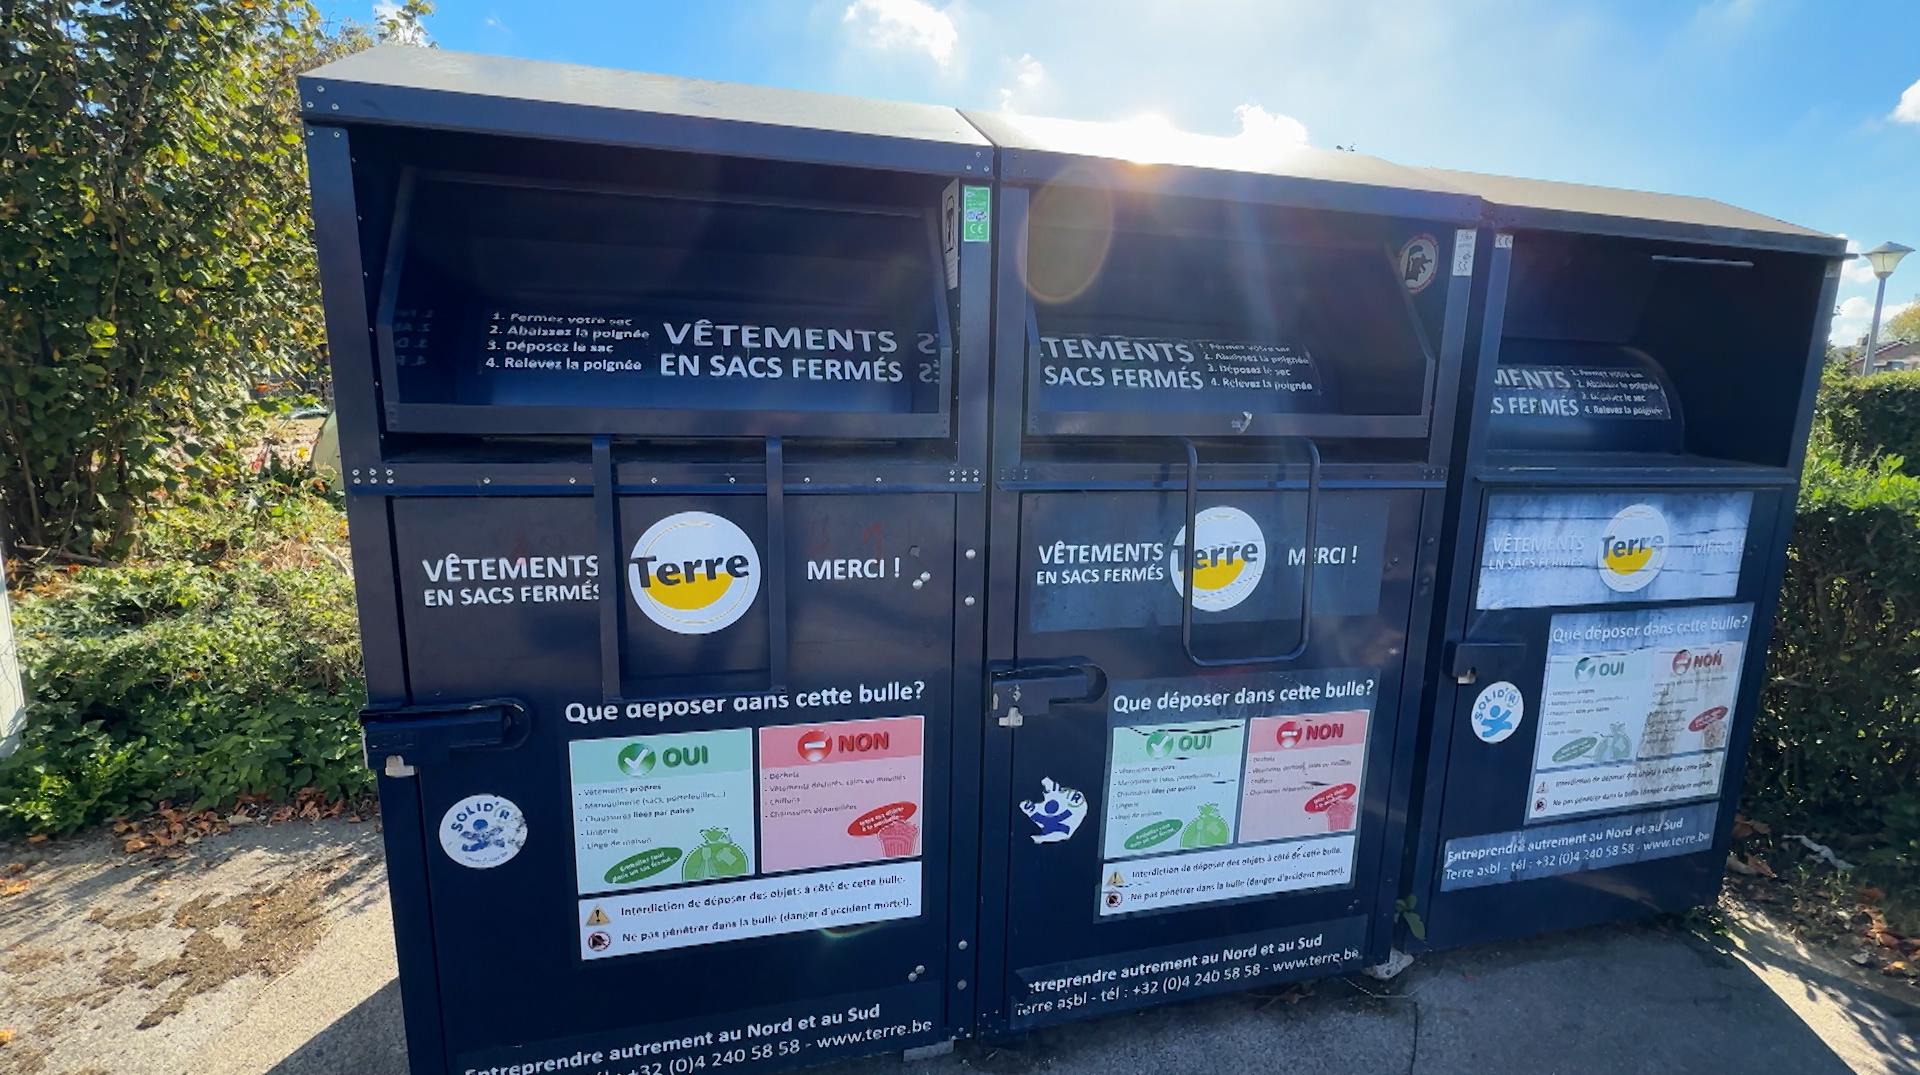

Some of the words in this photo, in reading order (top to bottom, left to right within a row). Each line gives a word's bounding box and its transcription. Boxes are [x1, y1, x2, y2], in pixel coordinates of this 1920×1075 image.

[489, 325, 502, 334] 2.
[507, 325, 572, 336] Abaissez
[576, 327, 588, 337] la
[592, 328, 649, 341] poignée
[663, 319, 897, 352] VÊTEMENTS
[486, 340, 501, 350] 3.
[506, 341, 569, 353] Déposez
[573, 341, 586, 352] le
[1040, 337, 1194, 363] TEMENTS
[485, 357, 500, 368] 4.
[504, 357, 562, 369] Relevez
[566, 358, 579, 369] la
[583, 359, 642, 372] poignée
[660, 353, 700, 376] EN
[709, 354, 783, 378] SACS
[793, 356, 903, 383] FERMÉS
[1044, 365, 1105, 387] SACS
[1112, 367, 1204, 390] FERMÉS
[1509, 396, 1579, 416] FERMÉS
[1038, 540, 1164, 564] VÊTEMENTS
[1288, 547, 1346, 566] MRCI
[1351, 545, 1358, 564] !
[1602, 535, 1664, 560] Terre
[422, 553, 598, 582] VÊTEMENTS
[629, 554, 749, 588] Terre
[807, 558, 885, 581] MERCI
[894, 557, 901, 578] !
[1036, 571, 1057, 586] EN
[1061, 569, 1100, 584] SACS
[1103, 563, 1164, 582] FERMÉS
[424, 589, 454, 606] EN
[460, 587, 515, 605] SACS
[1552, 627, 1581, 643] Que
[1585, 624, 1640, 642] déposer
[1643, 622, 1673, 636] dans
[1677, 620, 1705, 634] cette
[1711, 615, 1748, 630] bulle?
[1599, 661, 1624, 676] OUI
[1694, 653, 1723, 668] NON
[565, 703, 618, 724] Que
[796, 687, 852, 708] cette
[859, 681, 925, 703] bulle?
[1113, 695, 1151, 714] Que
[1157, 691, 1230, 712] déposer
[1234, 687, 1275, 704] dans
[1280, 685, 1321, 702] cette
[1325, 679, 1374, 698] bulle?
[839, 731, 889, 752] NON
[1178, 735, 1212, 752] OUI
[1306, 723, 1344, 740] NON
[663, 745, 708, 767] OUI
[451, 801, 510, 832] SOLID'R
[1528, 833, 1586, 852] autrement
[1589, 832, 1602, 842] au
[1606, 826, 1632, 840] Nord
[1635, 824, 1645, 834] et
[1648, 824, 1661, 833] au
[1664, 818, 1683, 830] Sud
[1446, 867, 1474, 880] Terre
[1559, 851, 1579, 866] (0)4
[1606, 845, 1618, 857] 58
[1643, 831, 1710, 851] www.terre.be
[621, 902, 685, 916] Interdiction
[687, 899, 701, 908] de
[704, 895, 747, 908] déposer
[712, 920, 737, 930] dans
[739, 917, 749, 927] la
[780, 910, 818, 923] (danger
[1028, 970, 1117, 994] treprendre
[1121, 955, 1198, 979] autrement
[1202, 953, 1218, 966] au
[1223, 944, 1257, 962] Nord
[1261, 943, 1274, 956] et
[1278, 941, 1294, 953] au
[1298, 933, 1322, 950] Sud
[1101, 986, 1119, 1002] tél
[1132, 981, 1158, 996] +32
[1163, 975, 1190, 994] (0)4
[1194, 970, 1220, 986] 240
[1224, 967, 1240, 980] 58
[1244, 963, 1260, 977] 58
[1273, 948, 1358, 972] www.terre.be
[609, 1032, 713, 1060] autrement
[719, 1028, 741, 1044] au
[747, 1017, 792, 1038] Nord
[798, 1014, 816, 1030] et
[821, 1011, 843, 1027] au
[847, 1003, 880, 1022] Sud
[669, 1055, 705, 1075] (0)4
[712, 1048, 745, 1067] 240
[751, 1043, 773, 1060] 58
[778, 1039, 800, 1056] 58
[817, 1019, 932, 1049] www.terre.be
